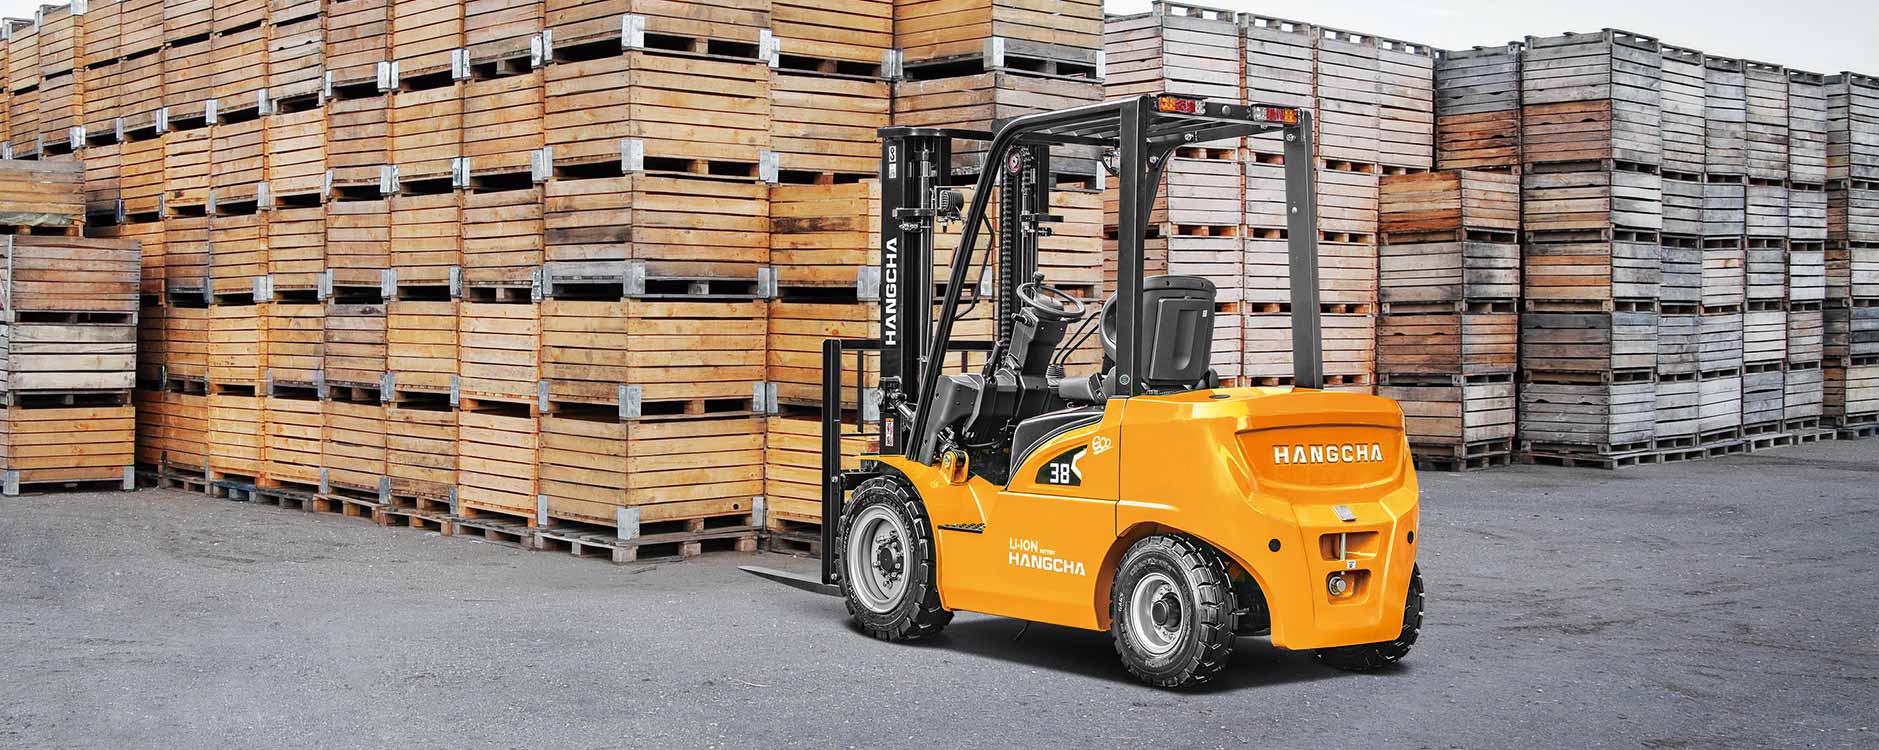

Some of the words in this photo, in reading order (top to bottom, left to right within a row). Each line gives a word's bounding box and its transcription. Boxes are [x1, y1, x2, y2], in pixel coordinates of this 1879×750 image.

[885, 237, 897, 345] HANGCHA
[1273, 444, 1383, 464] HANGCHA
[1049, 462, 1070, 484] 38
[1008, 551, 1086, 577] HANGCHA
